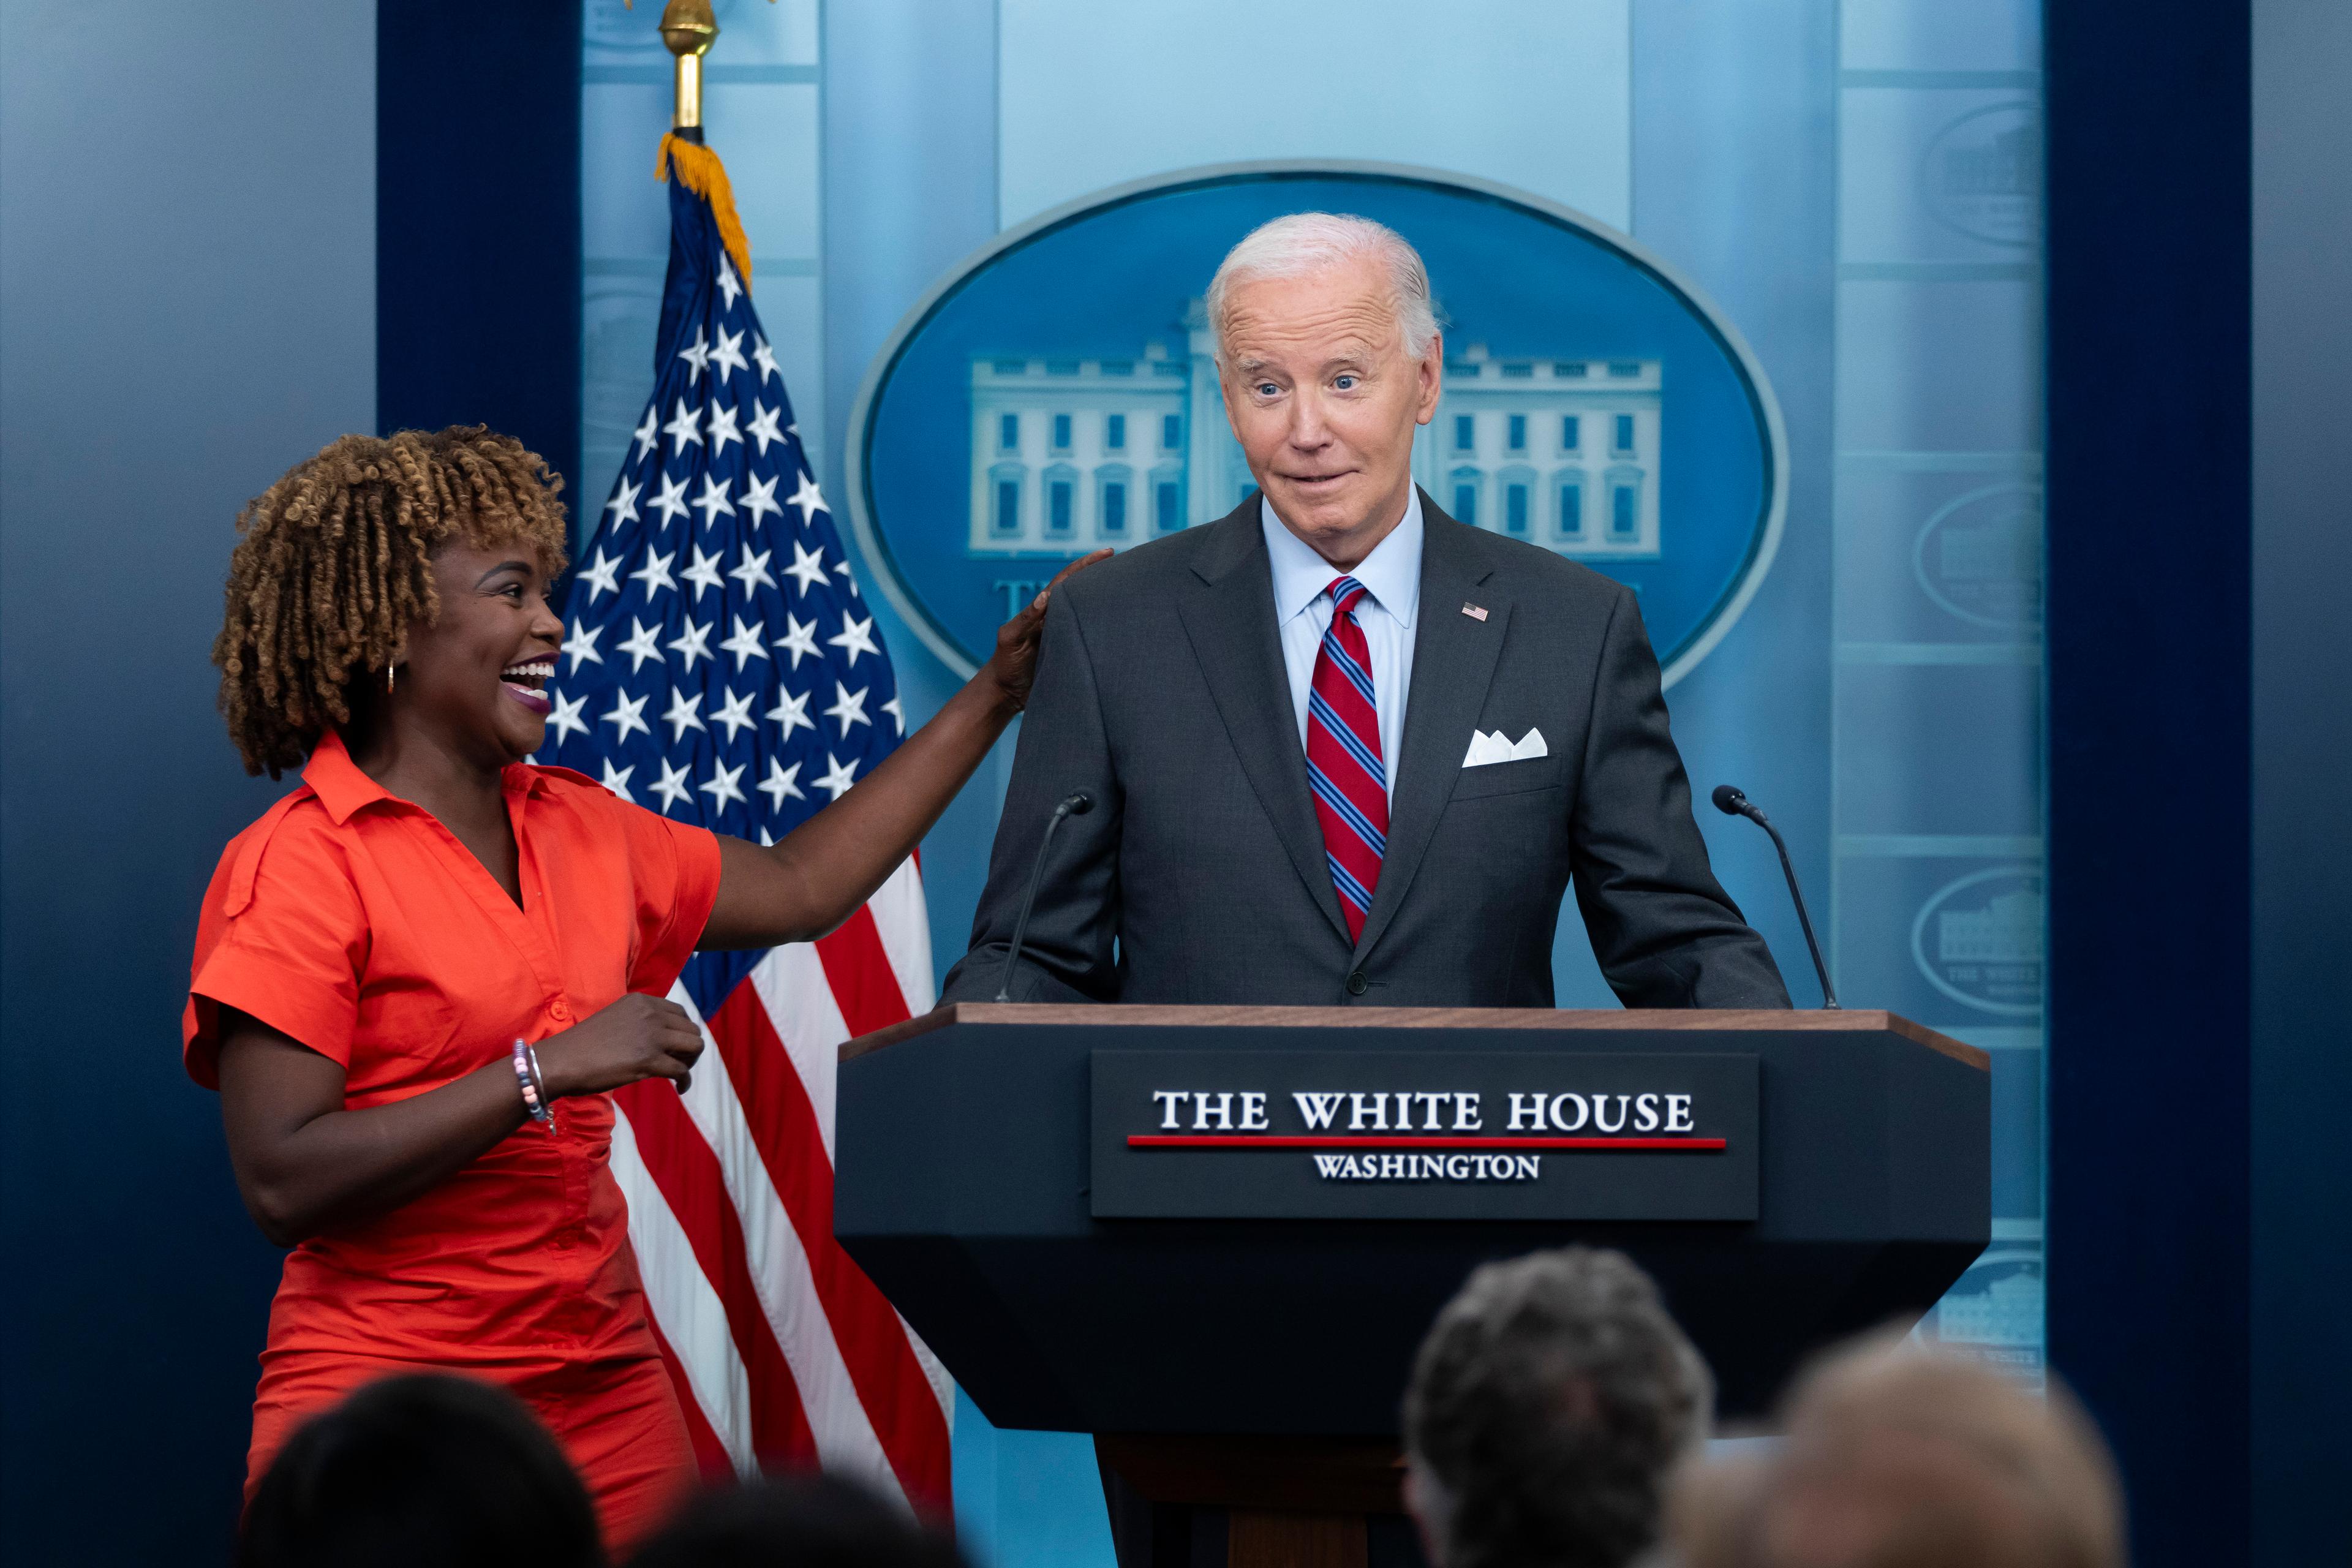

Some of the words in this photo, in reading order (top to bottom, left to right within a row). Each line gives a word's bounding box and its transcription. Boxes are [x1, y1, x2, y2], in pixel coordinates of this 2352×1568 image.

[1153, 1090, 1269, 1129] THE
[1292, 1091, 1483, 1130] WHITE
[1506, 1093, 1694, 1133] HOUSE
[1313, 1154, 1540, 1179] WASHINGTON
